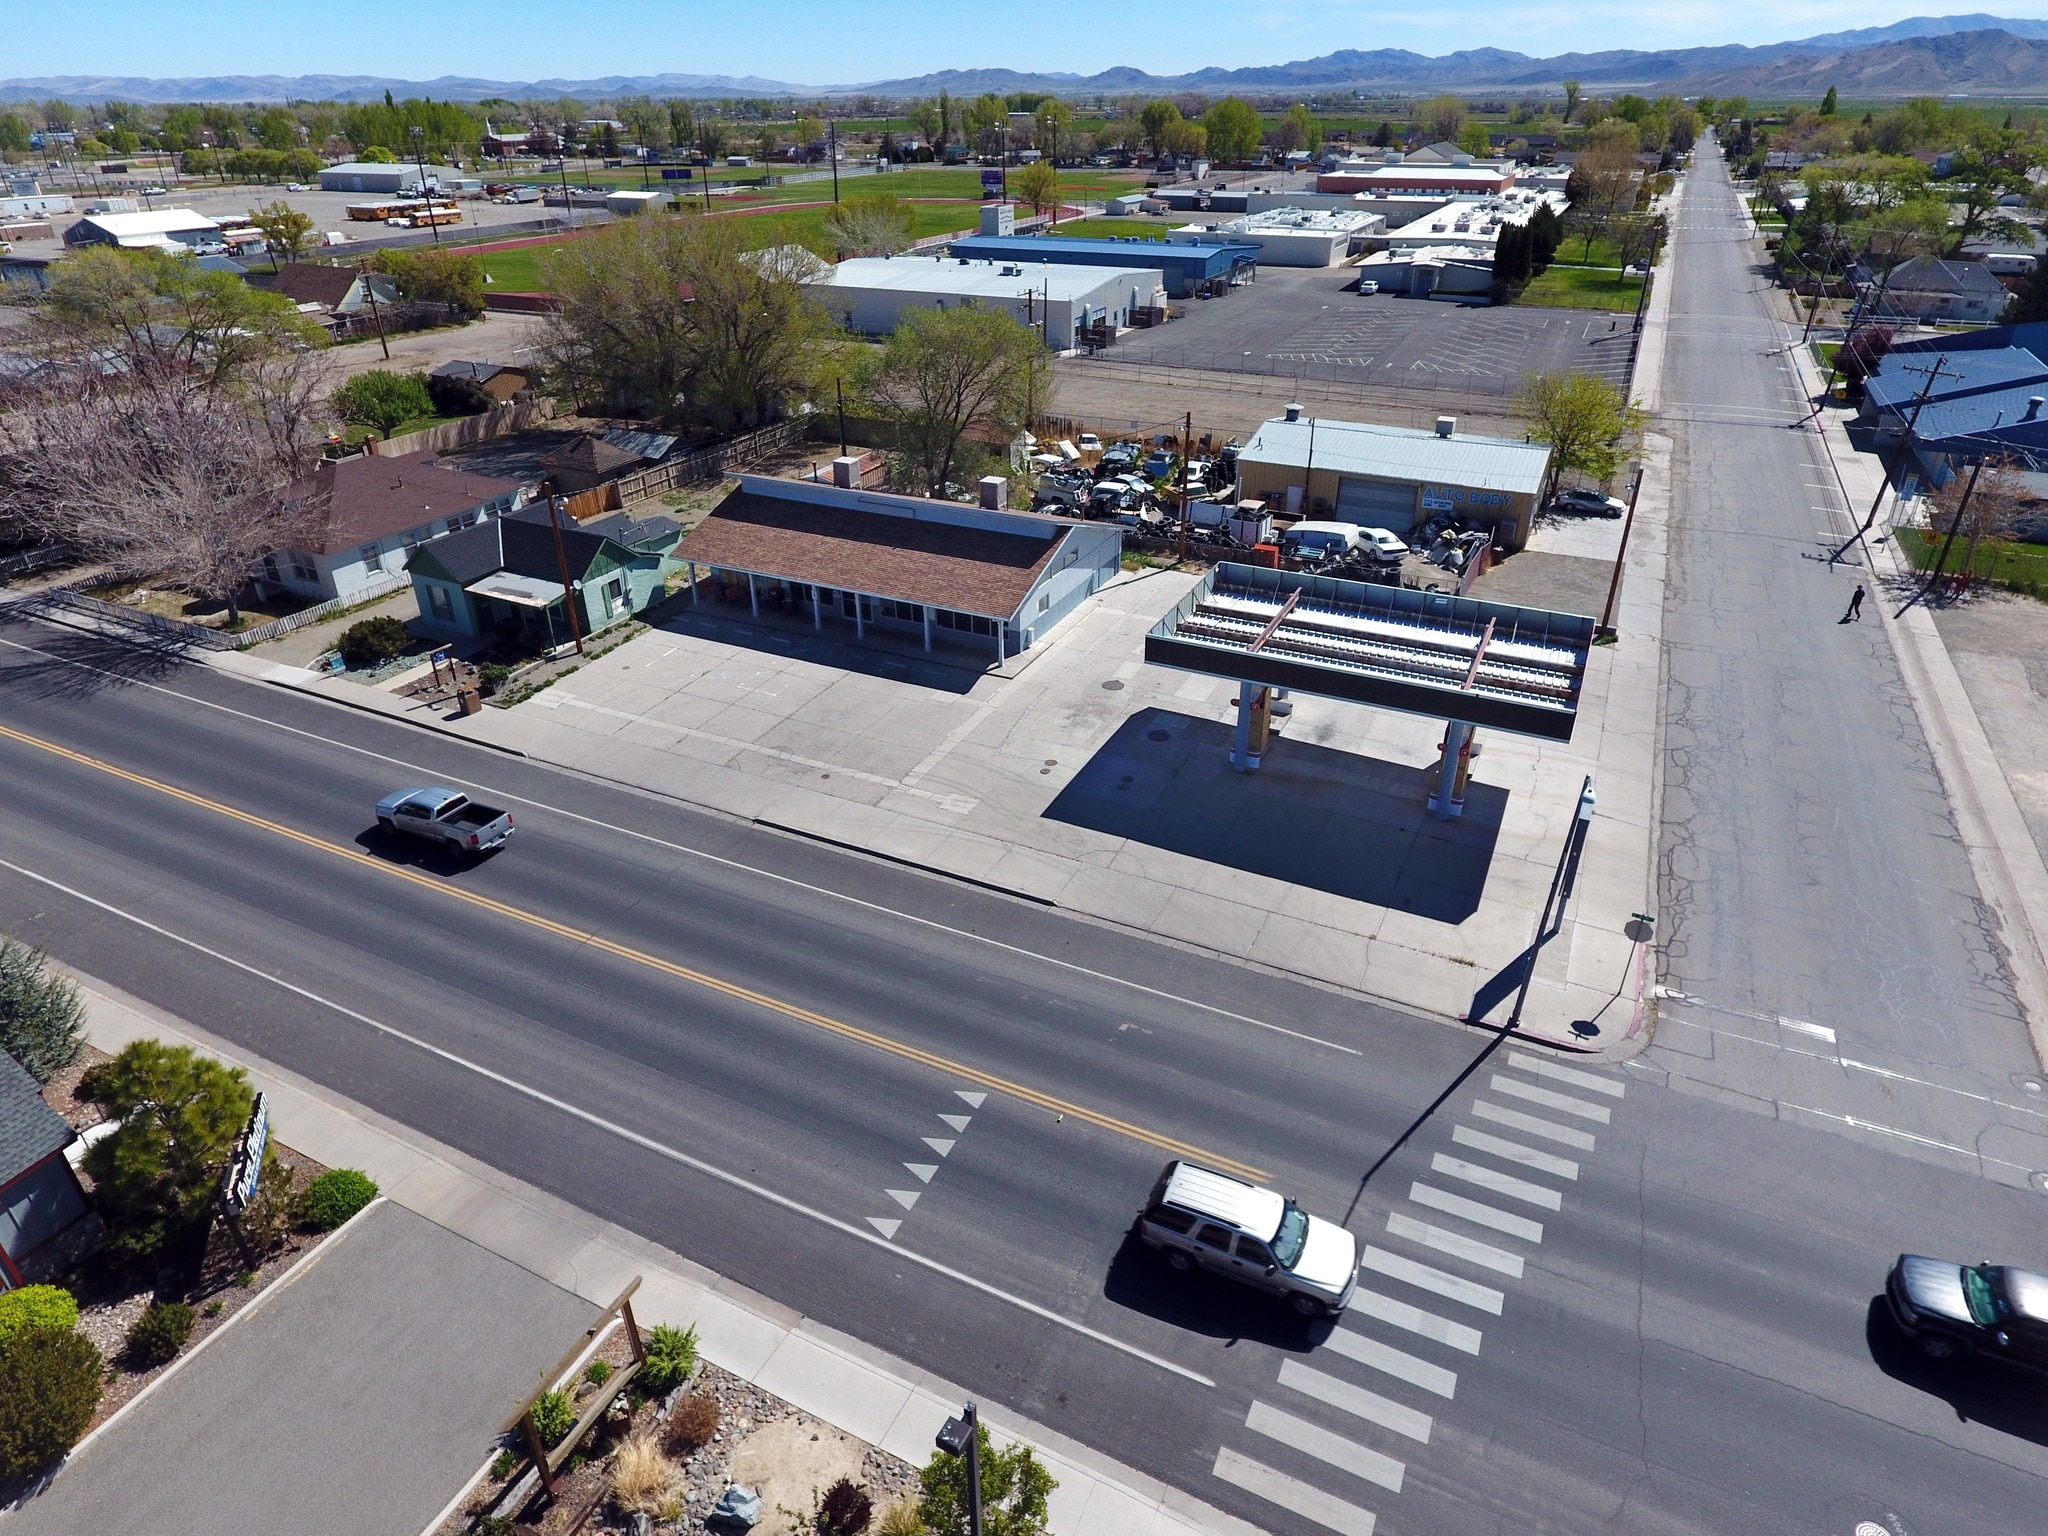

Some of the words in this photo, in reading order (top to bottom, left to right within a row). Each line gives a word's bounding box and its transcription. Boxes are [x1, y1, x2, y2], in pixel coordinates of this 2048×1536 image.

[1423, 486, 1465, 501] AUTO
[1469, 490, 1513, 507] BODY
[237, 1159, 254, 1207] Pure
[247, 1092, 268, 1160] Platinum
